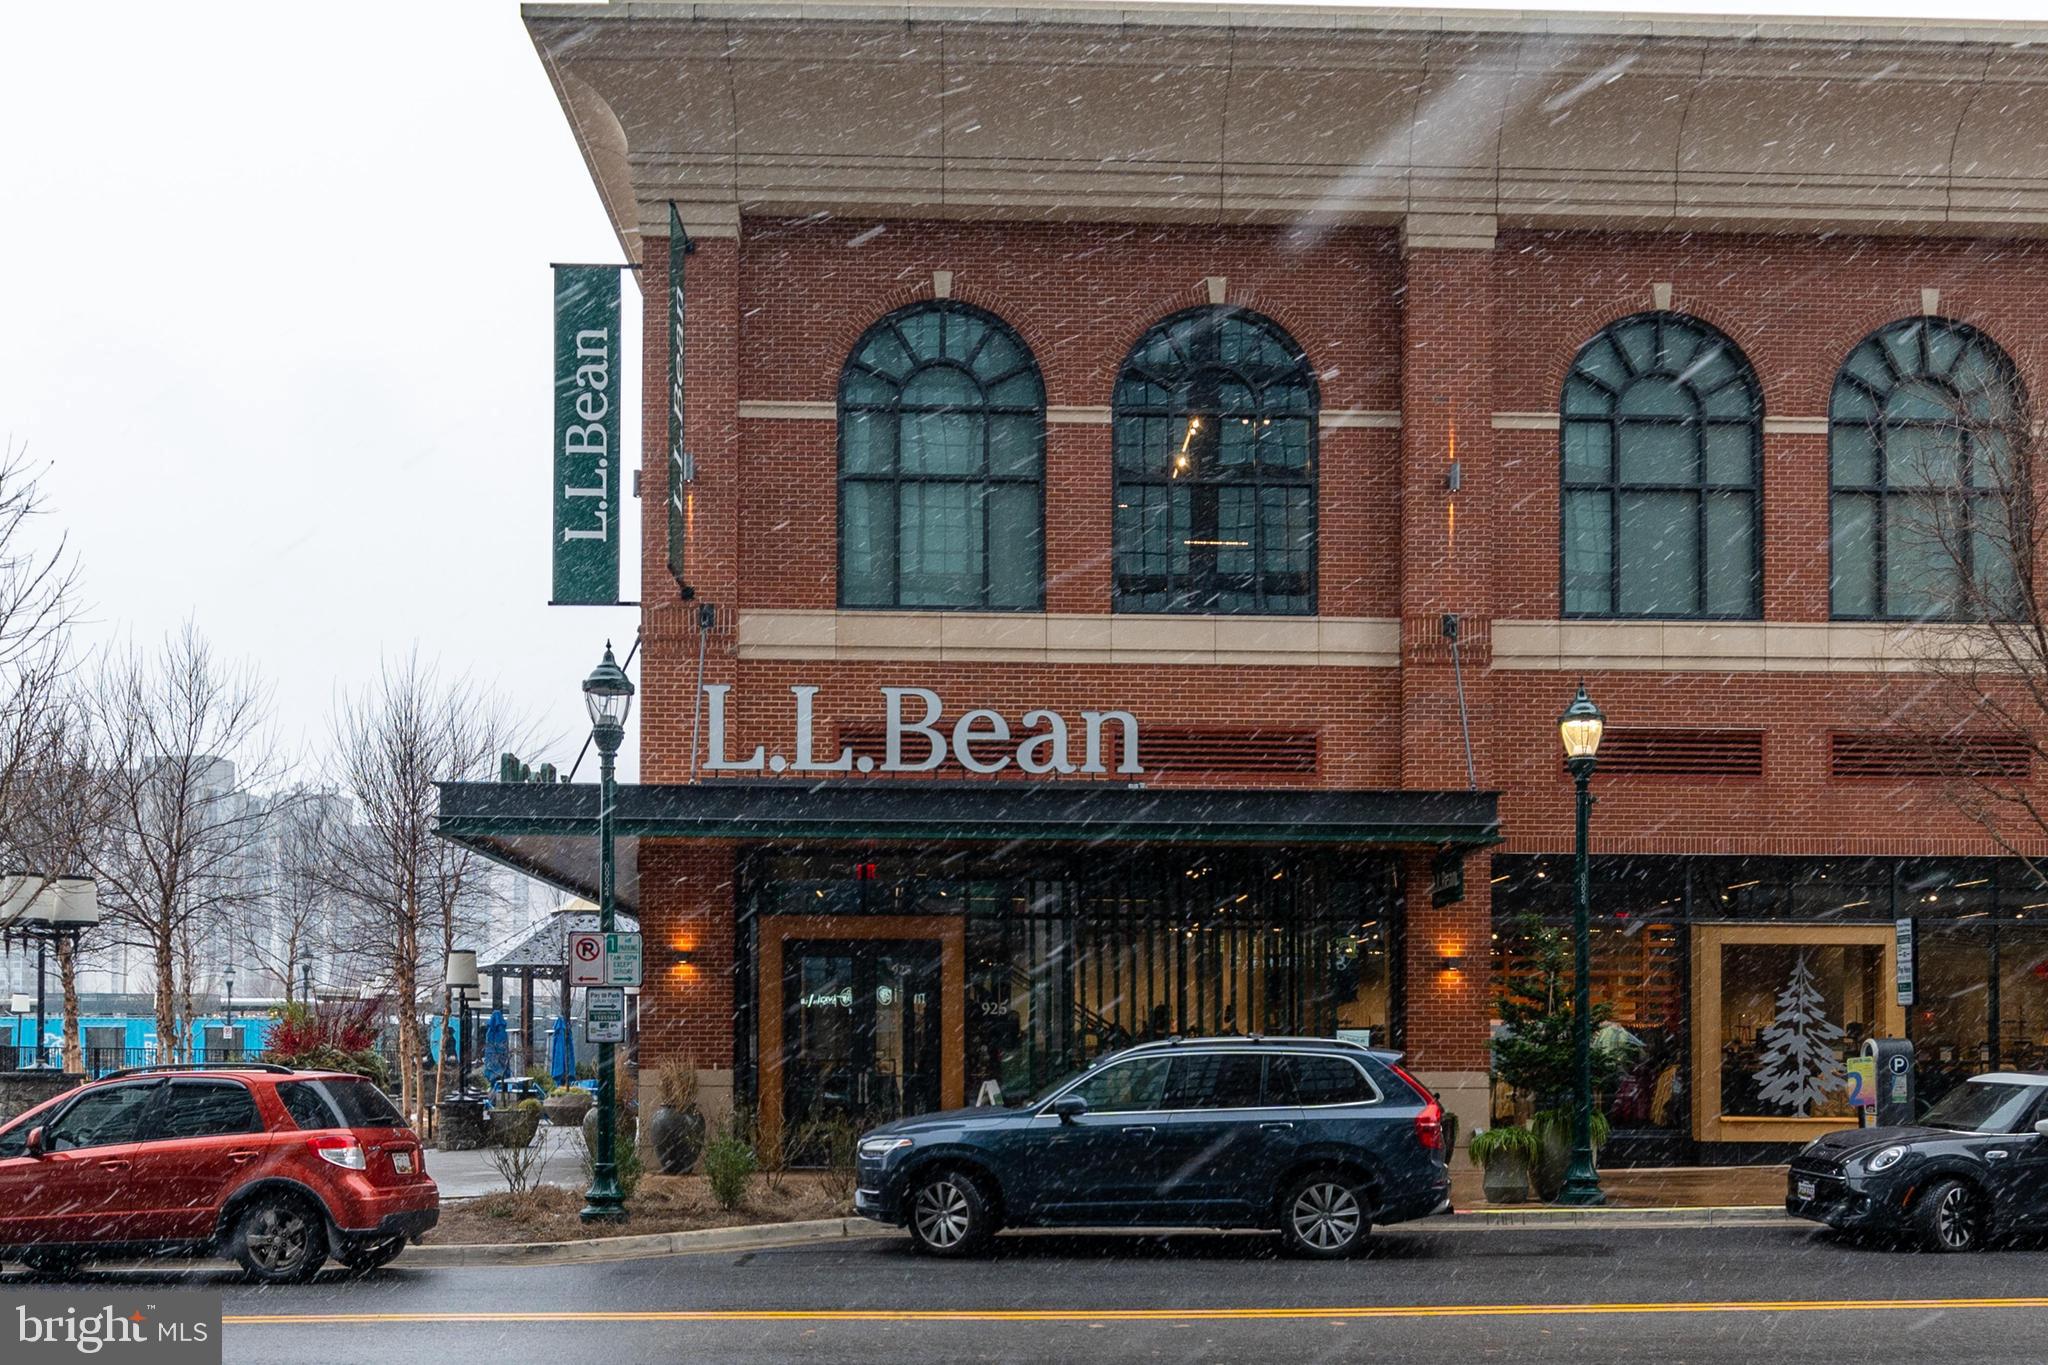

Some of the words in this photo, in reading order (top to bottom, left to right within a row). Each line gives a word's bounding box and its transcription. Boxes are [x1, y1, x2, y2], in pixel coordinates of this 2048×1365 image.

[673, 285, 684, 516] L.L.Bean
[563, 327, 609, 543] L.L.Bean
[702, 684, 1145, 774] L.L.Bean
[981, 1000, 1008, 1016] 925
[1847, 1072, 1865, 1106] 2
[1893, 1057, 1905, 1072] P
